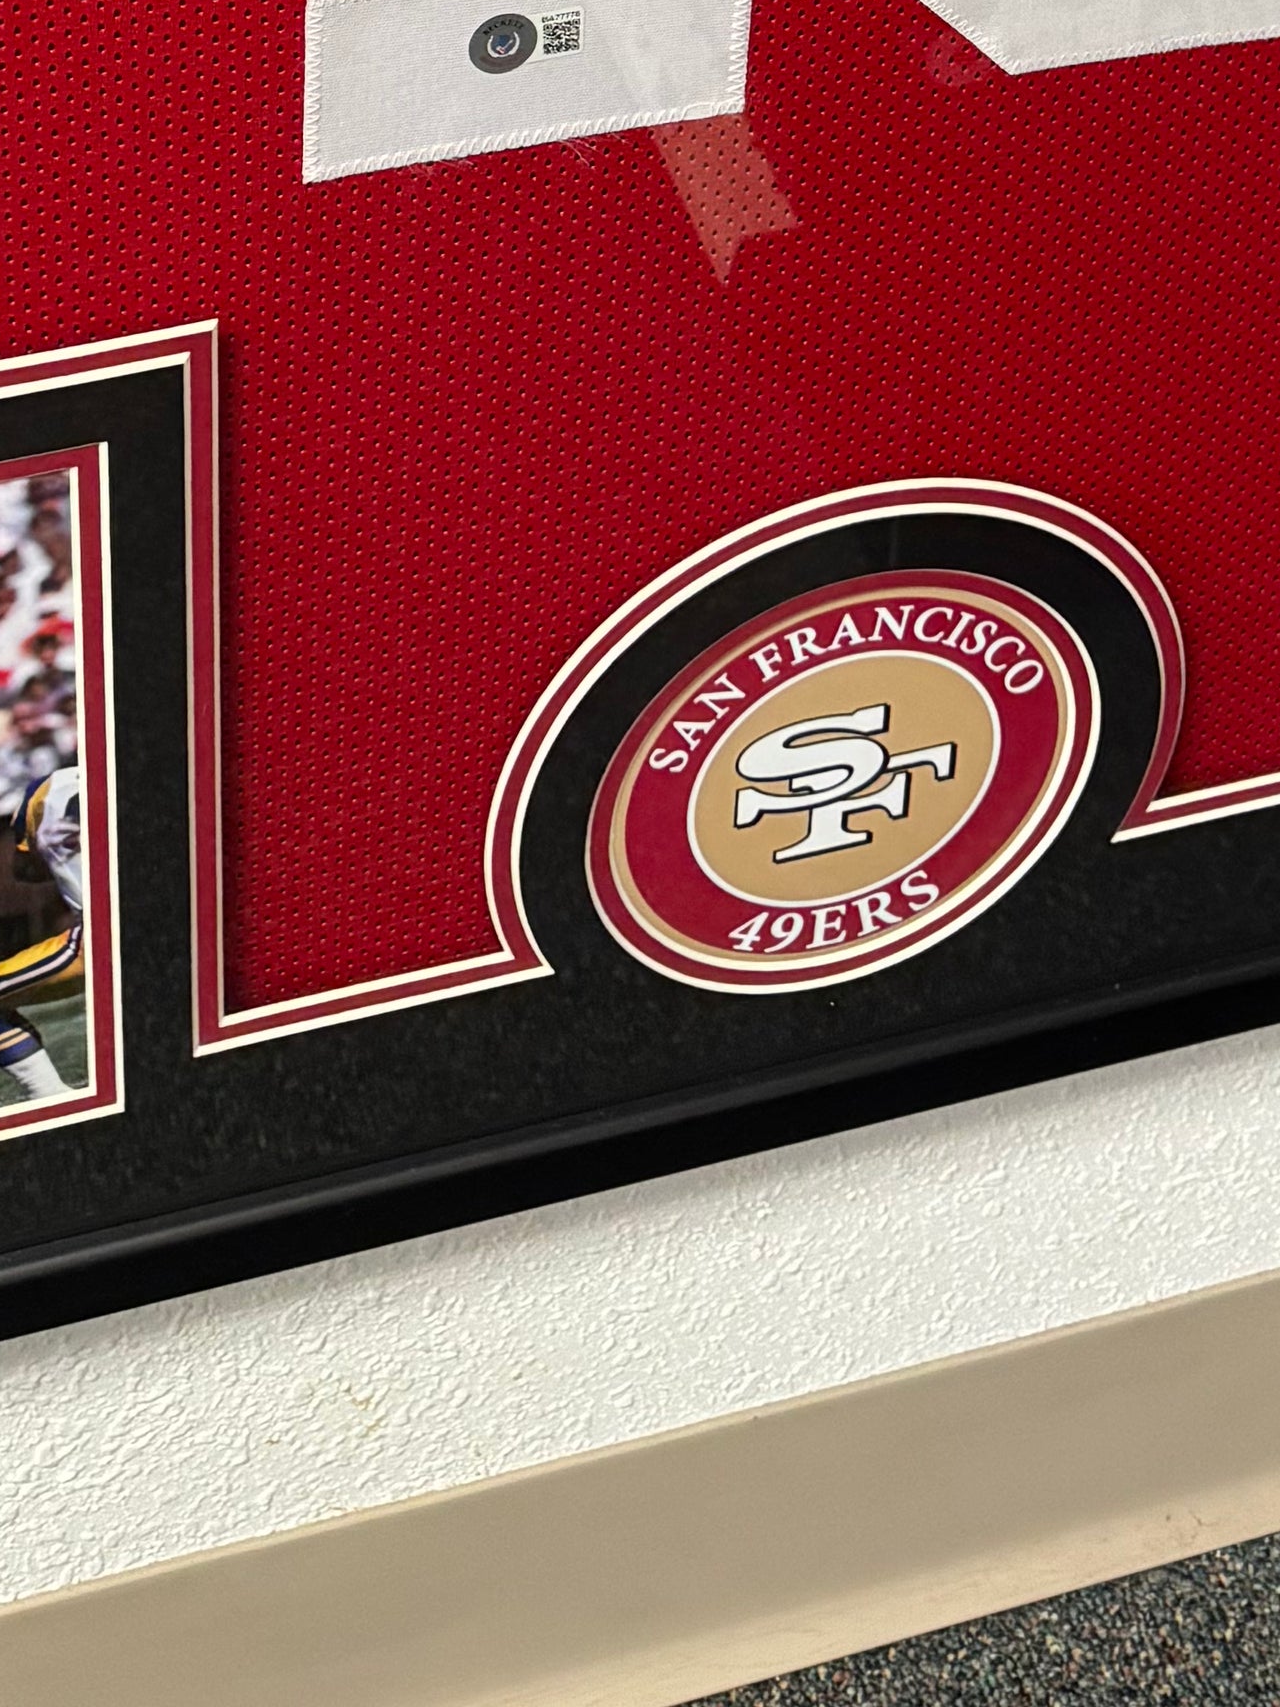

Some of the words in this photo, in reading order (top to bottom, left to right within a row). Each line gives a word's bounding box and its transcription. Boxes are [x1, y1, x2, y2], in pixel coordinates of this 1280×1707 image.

[648, 674, 748, 775] SAN
[748, 603, 1047, 697] FRANCISCO
[733, 703, 958, 865] SF
[726, 868, 941, 955] 49ERS
